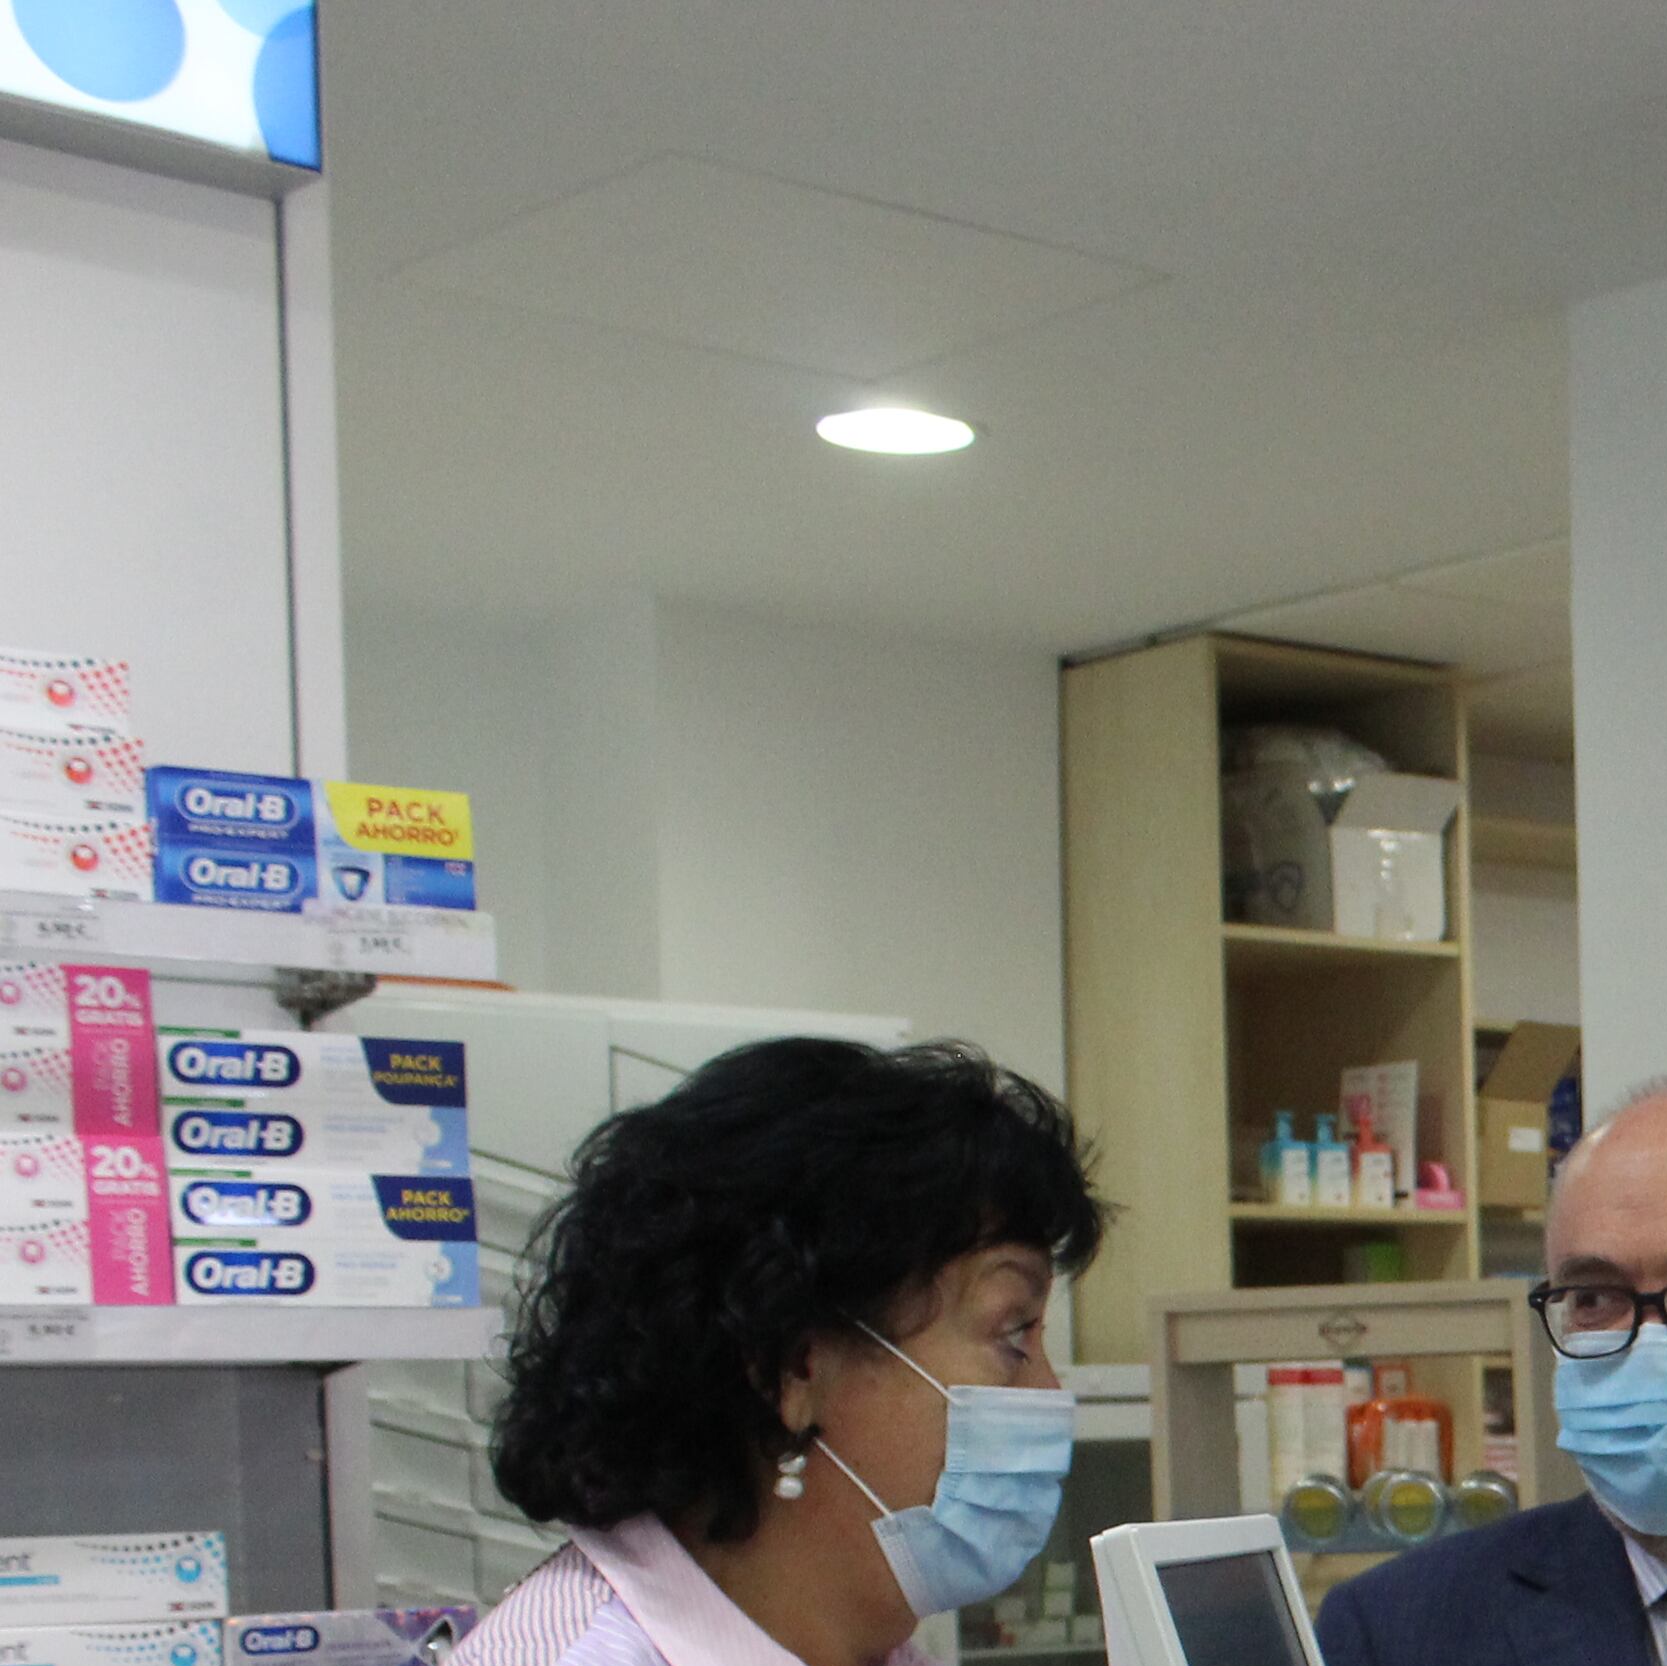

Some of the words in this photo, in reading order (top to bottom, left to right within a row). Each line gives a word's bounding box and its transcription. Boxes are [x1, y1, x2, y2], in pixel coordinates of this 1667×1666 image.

[184, 788, 287, 821] Oral-B
[366, 798, 446, 825] PACK
[190, 858, 291, 890] Oral-B
[175, 1046, 291, 1083] Oral-B
[390, 1054, 443, 1071] PACK
[180, 1116, 295, 1152] Oral-B
[187, 1186, 302, 1221] Oral-B
[401, 1190, 453, 1206] PACK
[192, 1257, 306, 1291] Oral-B
